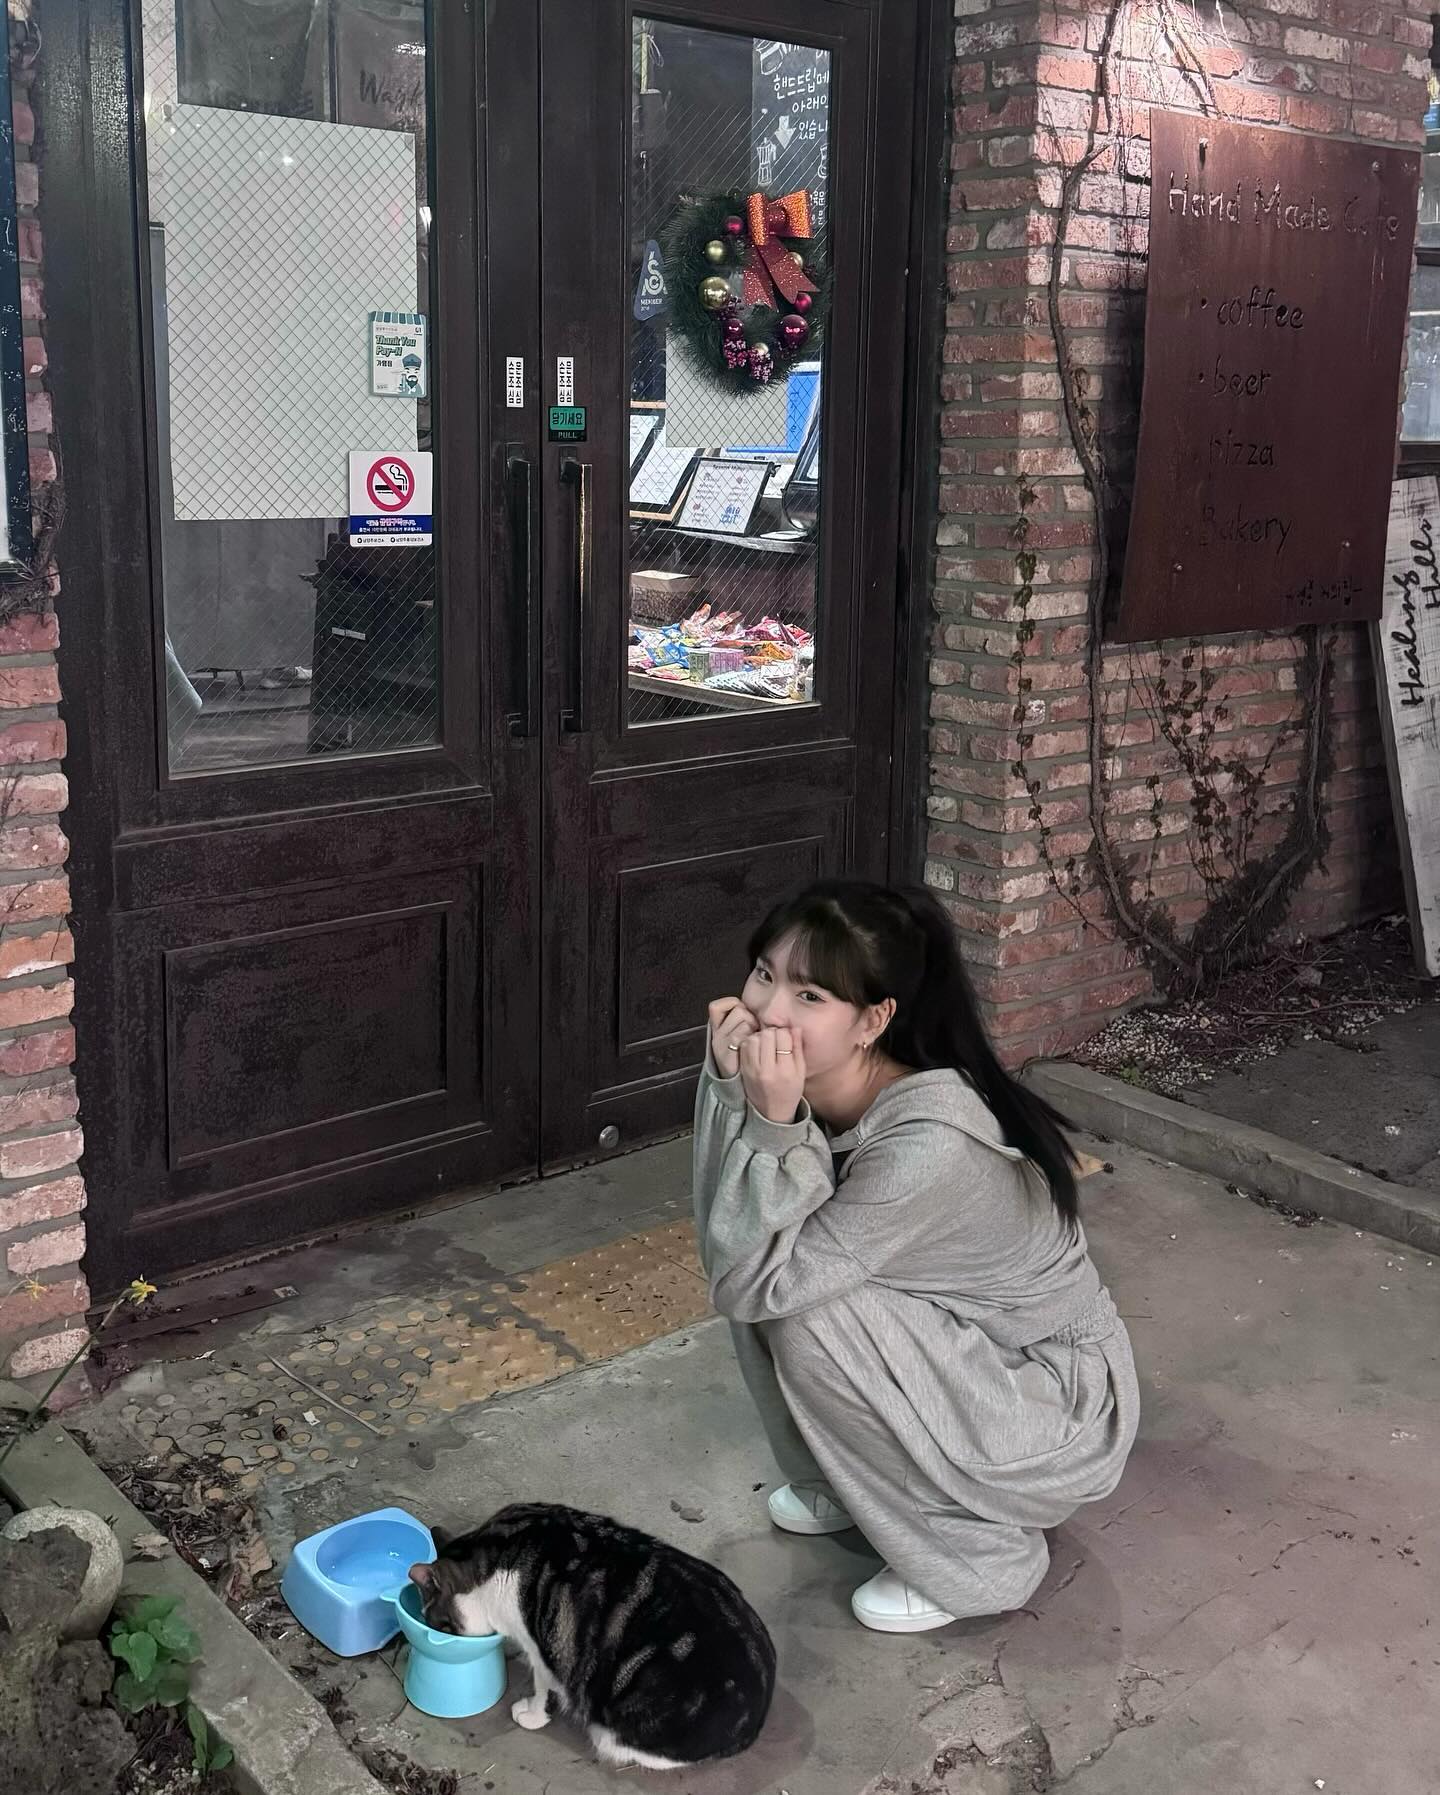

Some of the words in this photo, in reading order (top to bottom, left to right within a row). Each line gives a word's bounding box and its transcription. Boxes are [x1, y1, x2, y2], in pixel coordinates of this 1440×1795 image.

[1168, 170, 1242, 225] Hand
[1254, 177, 1333, 230] Made
[1216, 285, 1305, 329] coffee
[376, 334, 400, 346] Thank
[401, 337, 417, 347] You
[1213, 354, 1272, 397] beer
[552, 412, 583, 425] 당기세요
[557, 431, 578, 439] PULL
[1208, 429, 1275, 474] pizza
[1391, 570, 1425, 706] Healing
